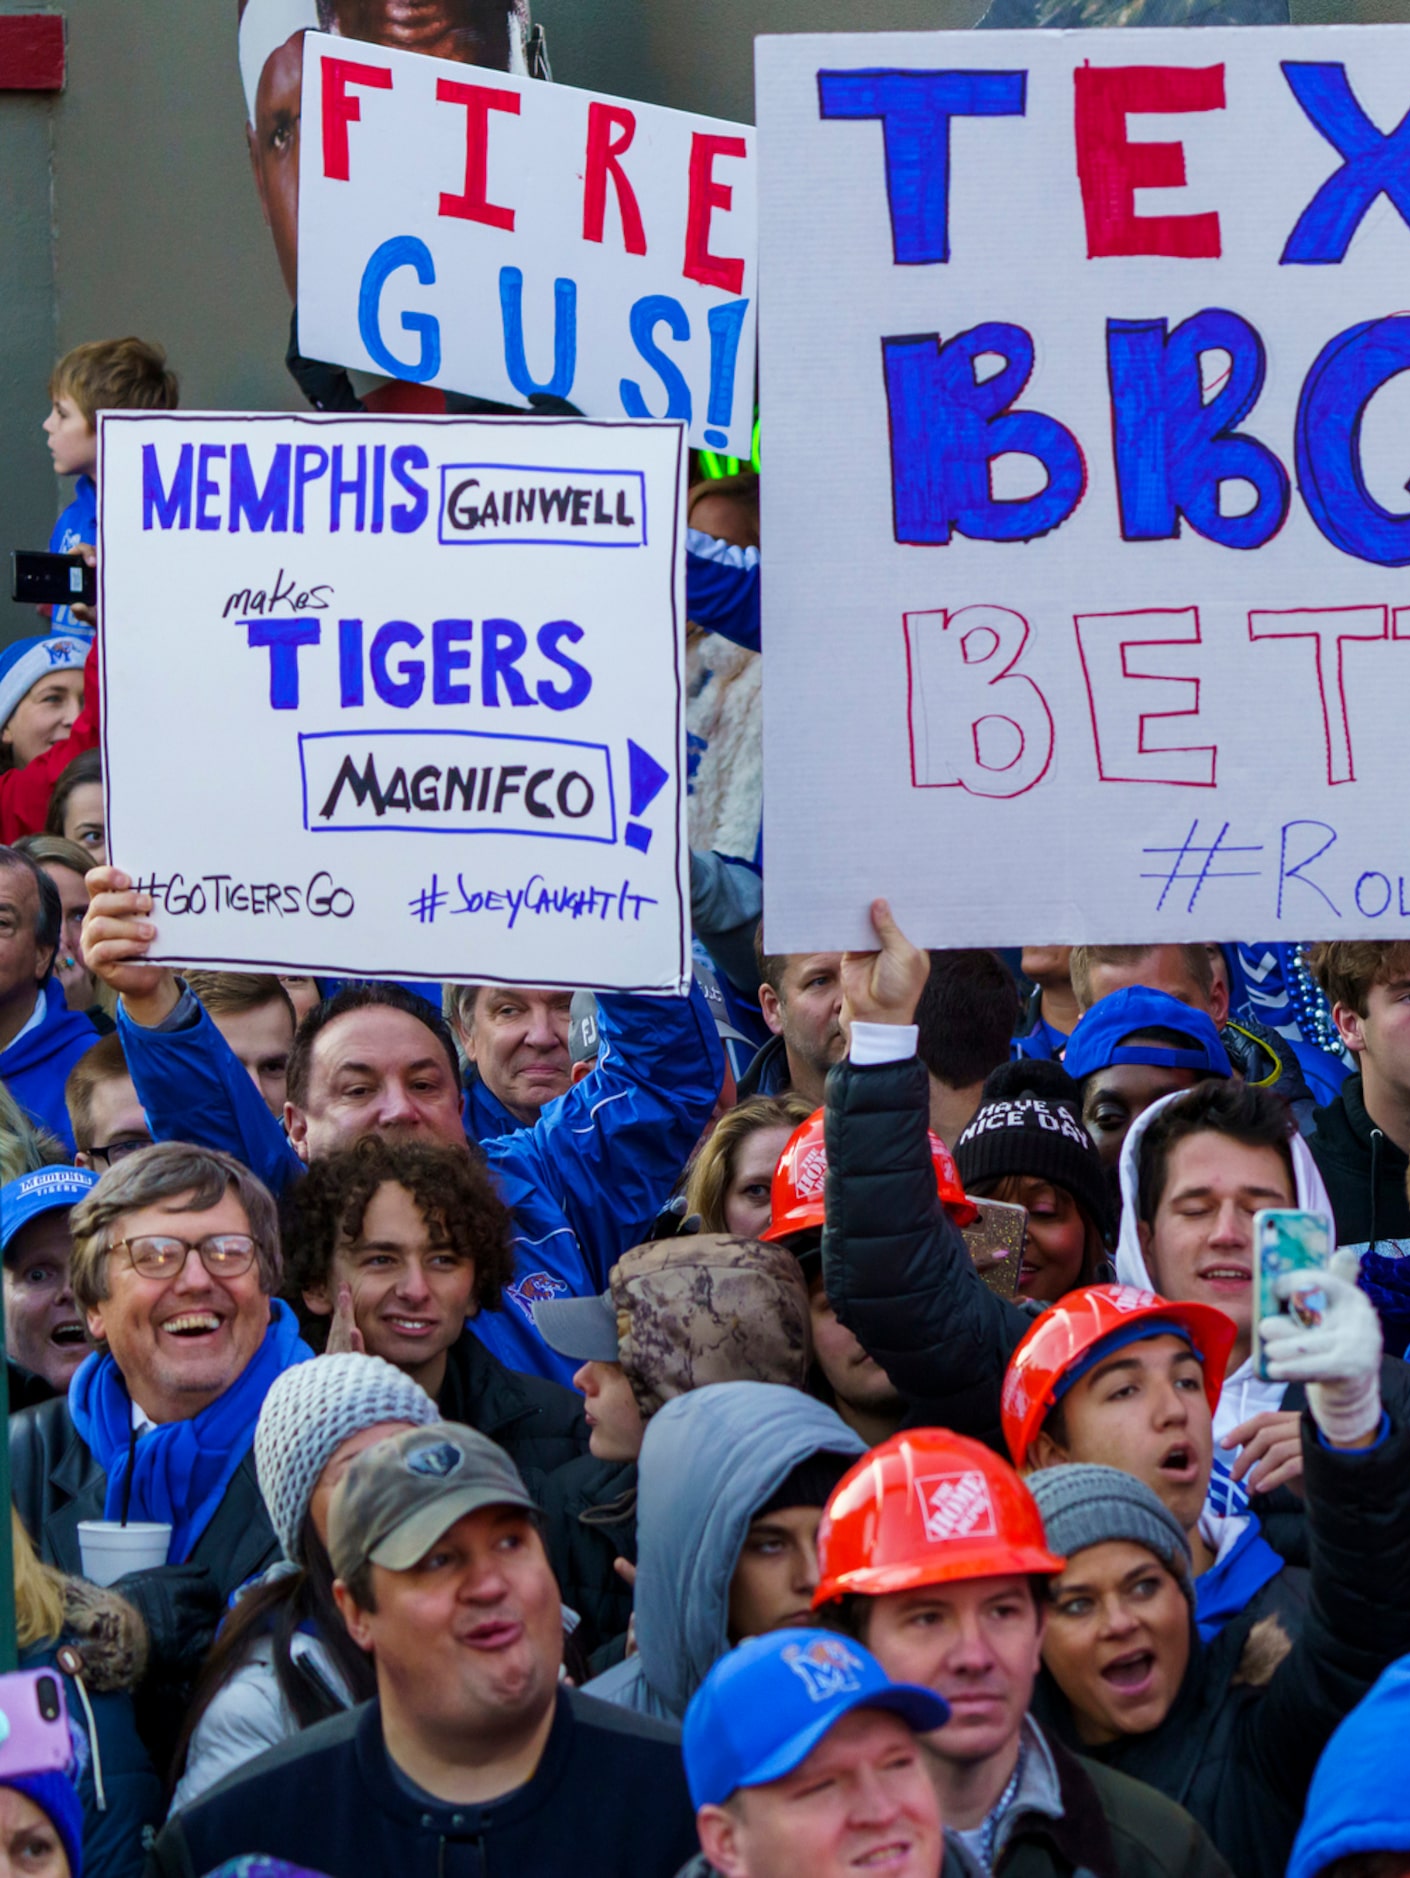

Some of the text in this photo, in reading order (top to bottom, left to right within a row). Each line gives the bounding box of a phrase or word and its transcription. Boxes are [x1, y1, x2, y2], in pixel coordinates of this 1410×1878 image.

[320, 55, 747, 295] FIRE
[358, 235, 749, 450] GUS!
[142, 443, 636, 534] MEMPHIS GAINWELL
[222, 568, 337, 620] makes
[236, 617, 592, 711] TIGERS
[320, 753, 594, 820] MAGNIFCO
[960, 1111, 1089, 1150] NICE DAY
[977, 1099, 1076, 1125] HAVE A
